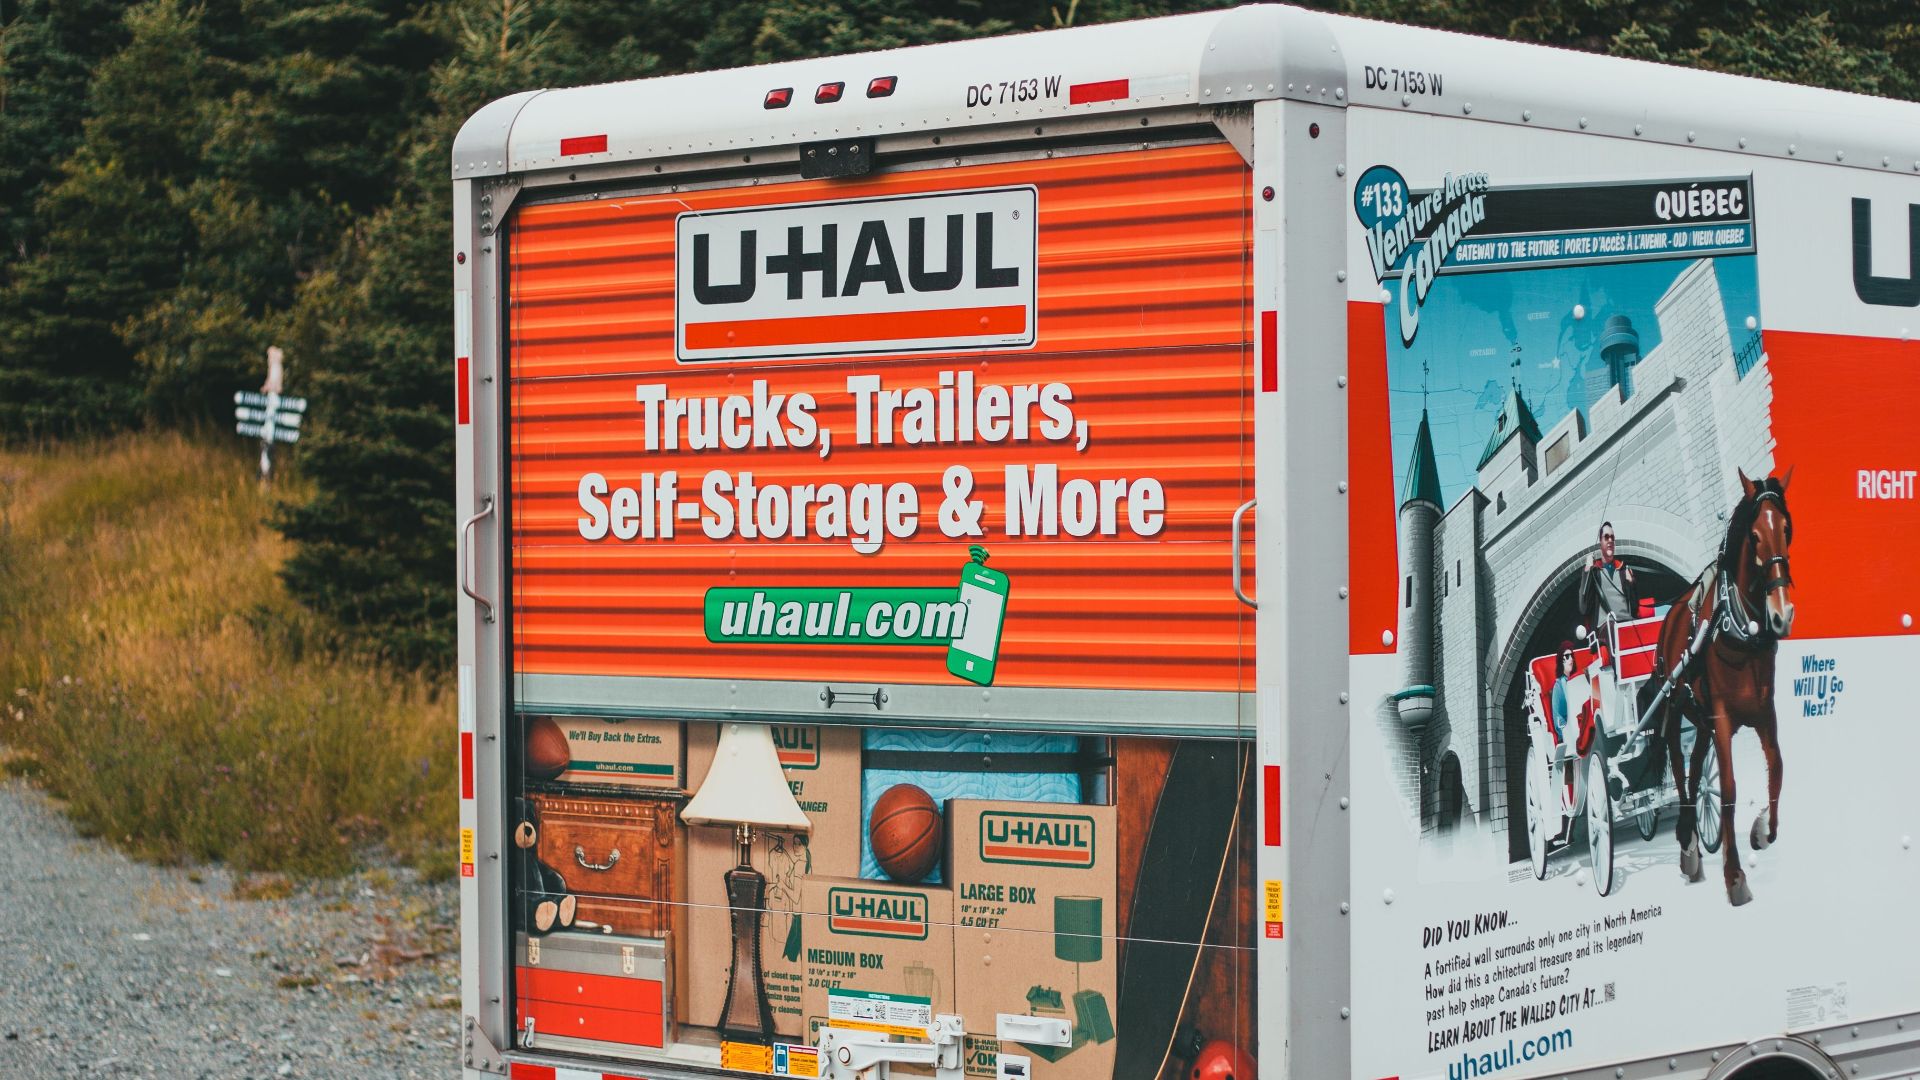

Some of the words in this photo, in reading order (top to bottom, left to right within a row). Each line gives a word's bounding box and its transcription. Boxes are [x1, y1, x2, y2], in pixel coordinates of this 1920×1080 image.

[966, 83, 993, 108] DC
[999, 78, 1038, 104] 7153
[1044, 75, 1062, 98] W
[1365, 65, 1388, 90] DC
[1391, 69, 1426, 94] 7153
[1428, 73, 1443, 96] W
[1361, 181, 1403, 218] #133
[1655, 183, 1744, 221] QUÉBEC
[1366, 188, 1443, 281] Venture
[1444, 172, 1489, 203] Across
[693, 211, 1019, 305] U-HAUL
[1455, 242, 1496, 261] GATEWAY
[1497, 242, 1509, 259] TO
[1510, 241, 1527, 258] THE
[1528, 239, 1560, 257] FUTURE
[1564, 237, 1591, 254] PORTE
[1592, 233, 1626, 253] D'ACCÈS
[1627, 232, 1633, 250] À
[1634, 232, 1668, 250] L'AVENIR
[1673, 231, 1687, 248] OLD
[1692, 229, 1714, 246] VIEUX
[1715, 228, 1745, 245] QUEBEC
[1851, 197, 1920, 307] U
[1400, 193, 1485, 342] Canada
[636, 379, 830, 458] Trucks,
[847, 371, 1088, 452] Trailers,
[1858, 469, 1917, 500] RIGHT
[578, 470, 918, 554] Self-Storage
[937, 464, 985, 538] &
[1004, 463, 1165, 537] More
[720, 592, 968, 638] uhaul.com
[1802, 654, 1836, 673] Where
[1794, 677, 1815, 696] Will
[1817, 675, 1827, 699] U
[1830, 676, 1844, 693] Go
[569, 730, 586, 741] We'll
[588, 731, 602, 743] Buy
[604, 732, 621, 742] Back
[623, 733, 635, 742] the
[637, 734, 662, 744] Extras.
[596, 764, 634, 772] uhaul.com
[987, 819, 1087, 848] U-HAUL
[835, 895, 921, 922] U-HAUL
[960, 883, 1004, 902] LARGE
[1009, 886, 1036, 904] BOX
[960, 916, 974, 926] 4.5
[976, 917, 987, 928] CU
[988, 918, 999, 929] FT
[1422, 926, 1443, 949] DID
[1447, 920, 1470, 942] YOU
[807, 948, 855, 967] MEDIUM
[860, 953, 884, 970] BOX
[1424, 963, 1432, 980] A
[1435, 952, 1471, 976] fortified
[1474, 947, 1492, 966] wall
[1495, 936, 1535, 961] surrounds
[1538, 930, 1556, 948] only
[1558, 930, 1573, 943] one
[1575, 923, 1591, 939] city
[1593, 920, 1601, 932] in
[1604, 911, 1627, 931] North
[1630, 905, 1662, 924] America
[771, 971, 788, 979] closet
[789, 974, 802, 982] spac
[1425, 984, 1445, 1001] How
[1448, 976, 1462, 994] did
[1465, 973, 1481, 990] this
[1540, 951, 1573, 970] treasure
[1575, 942, 1590, 959] and
[1593, 941, 1604, 954] its
[1606, 930, 1644, 952] legendary
[808, 978, 819, 988] 3.0
[821, 979, 830, 989] CU
[832, 980, 841, 989] FT
[1426, 1005, 1445, 1026] past
[1448, 998, 1467, 1016] help
[1470, 993, 1495, 1010] shape
[1498, 979, 1537, 1002] Canada's
[1540, 967, 1570, 990] future?
[1428, 1026, 1460, 1054] LEARN
[1462, 1016, 1496, 1043] ABOUT
[1499, 1010, 1517, 1033] THE
[1521, 1000, 1556, 1027] WALLED
[1559, 993, 1580, 1016] CITY
[1449, 1028, 1573, 1080] uhaul.com
